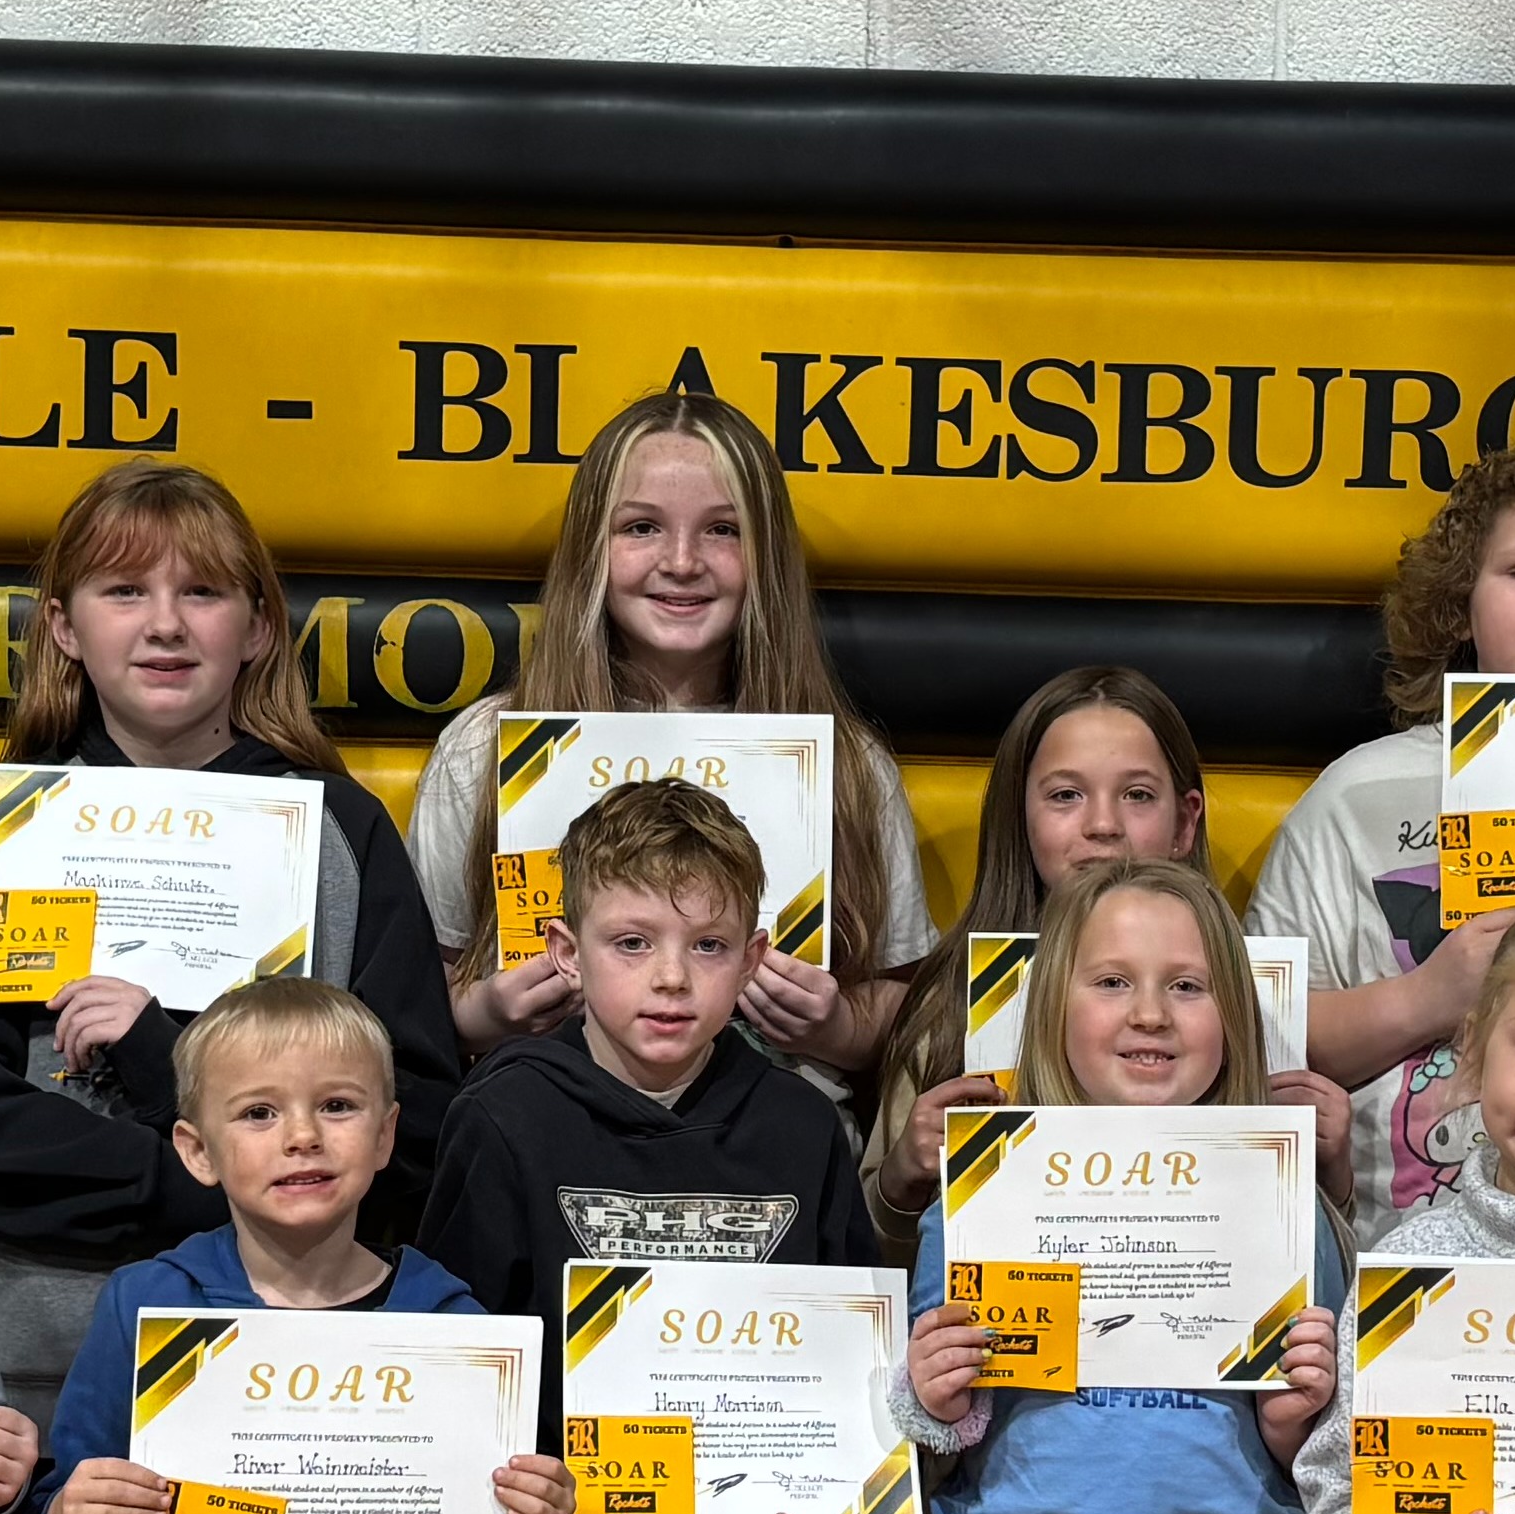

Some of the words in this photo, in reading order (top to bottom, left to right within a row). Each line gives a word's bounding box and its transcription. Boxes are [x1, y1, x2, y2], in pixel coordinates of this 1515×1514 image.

[74, 804, 216, 839] SOAR
[1493, 816, 1508, 827] 50
[1445, 911, 1462, 921] 50
[1044, 1150, 1201, 1187] SOAR
[585, 1206, 771, 1233] PHG
[607, 1240, 751, 1256] PERFORMANCE
[1038, 1235, 1089, 1262] Kyler
[1100, 1235, 1178, 1253] Johnson
[659, 1308, 804, 1346] SOAR
[244, 1362, 415, 1404] SOAR
[1464, 1393, 1513, 1414] Ella
[1416, 1425, 1434, 1436] 50
[1436, 1426, 1488, 1437] TICKETS
[233, 1453, 286, 1475] River
[586, 1460, 670, 1480] SOAR
[206, 1494, 226, 1509] 50
